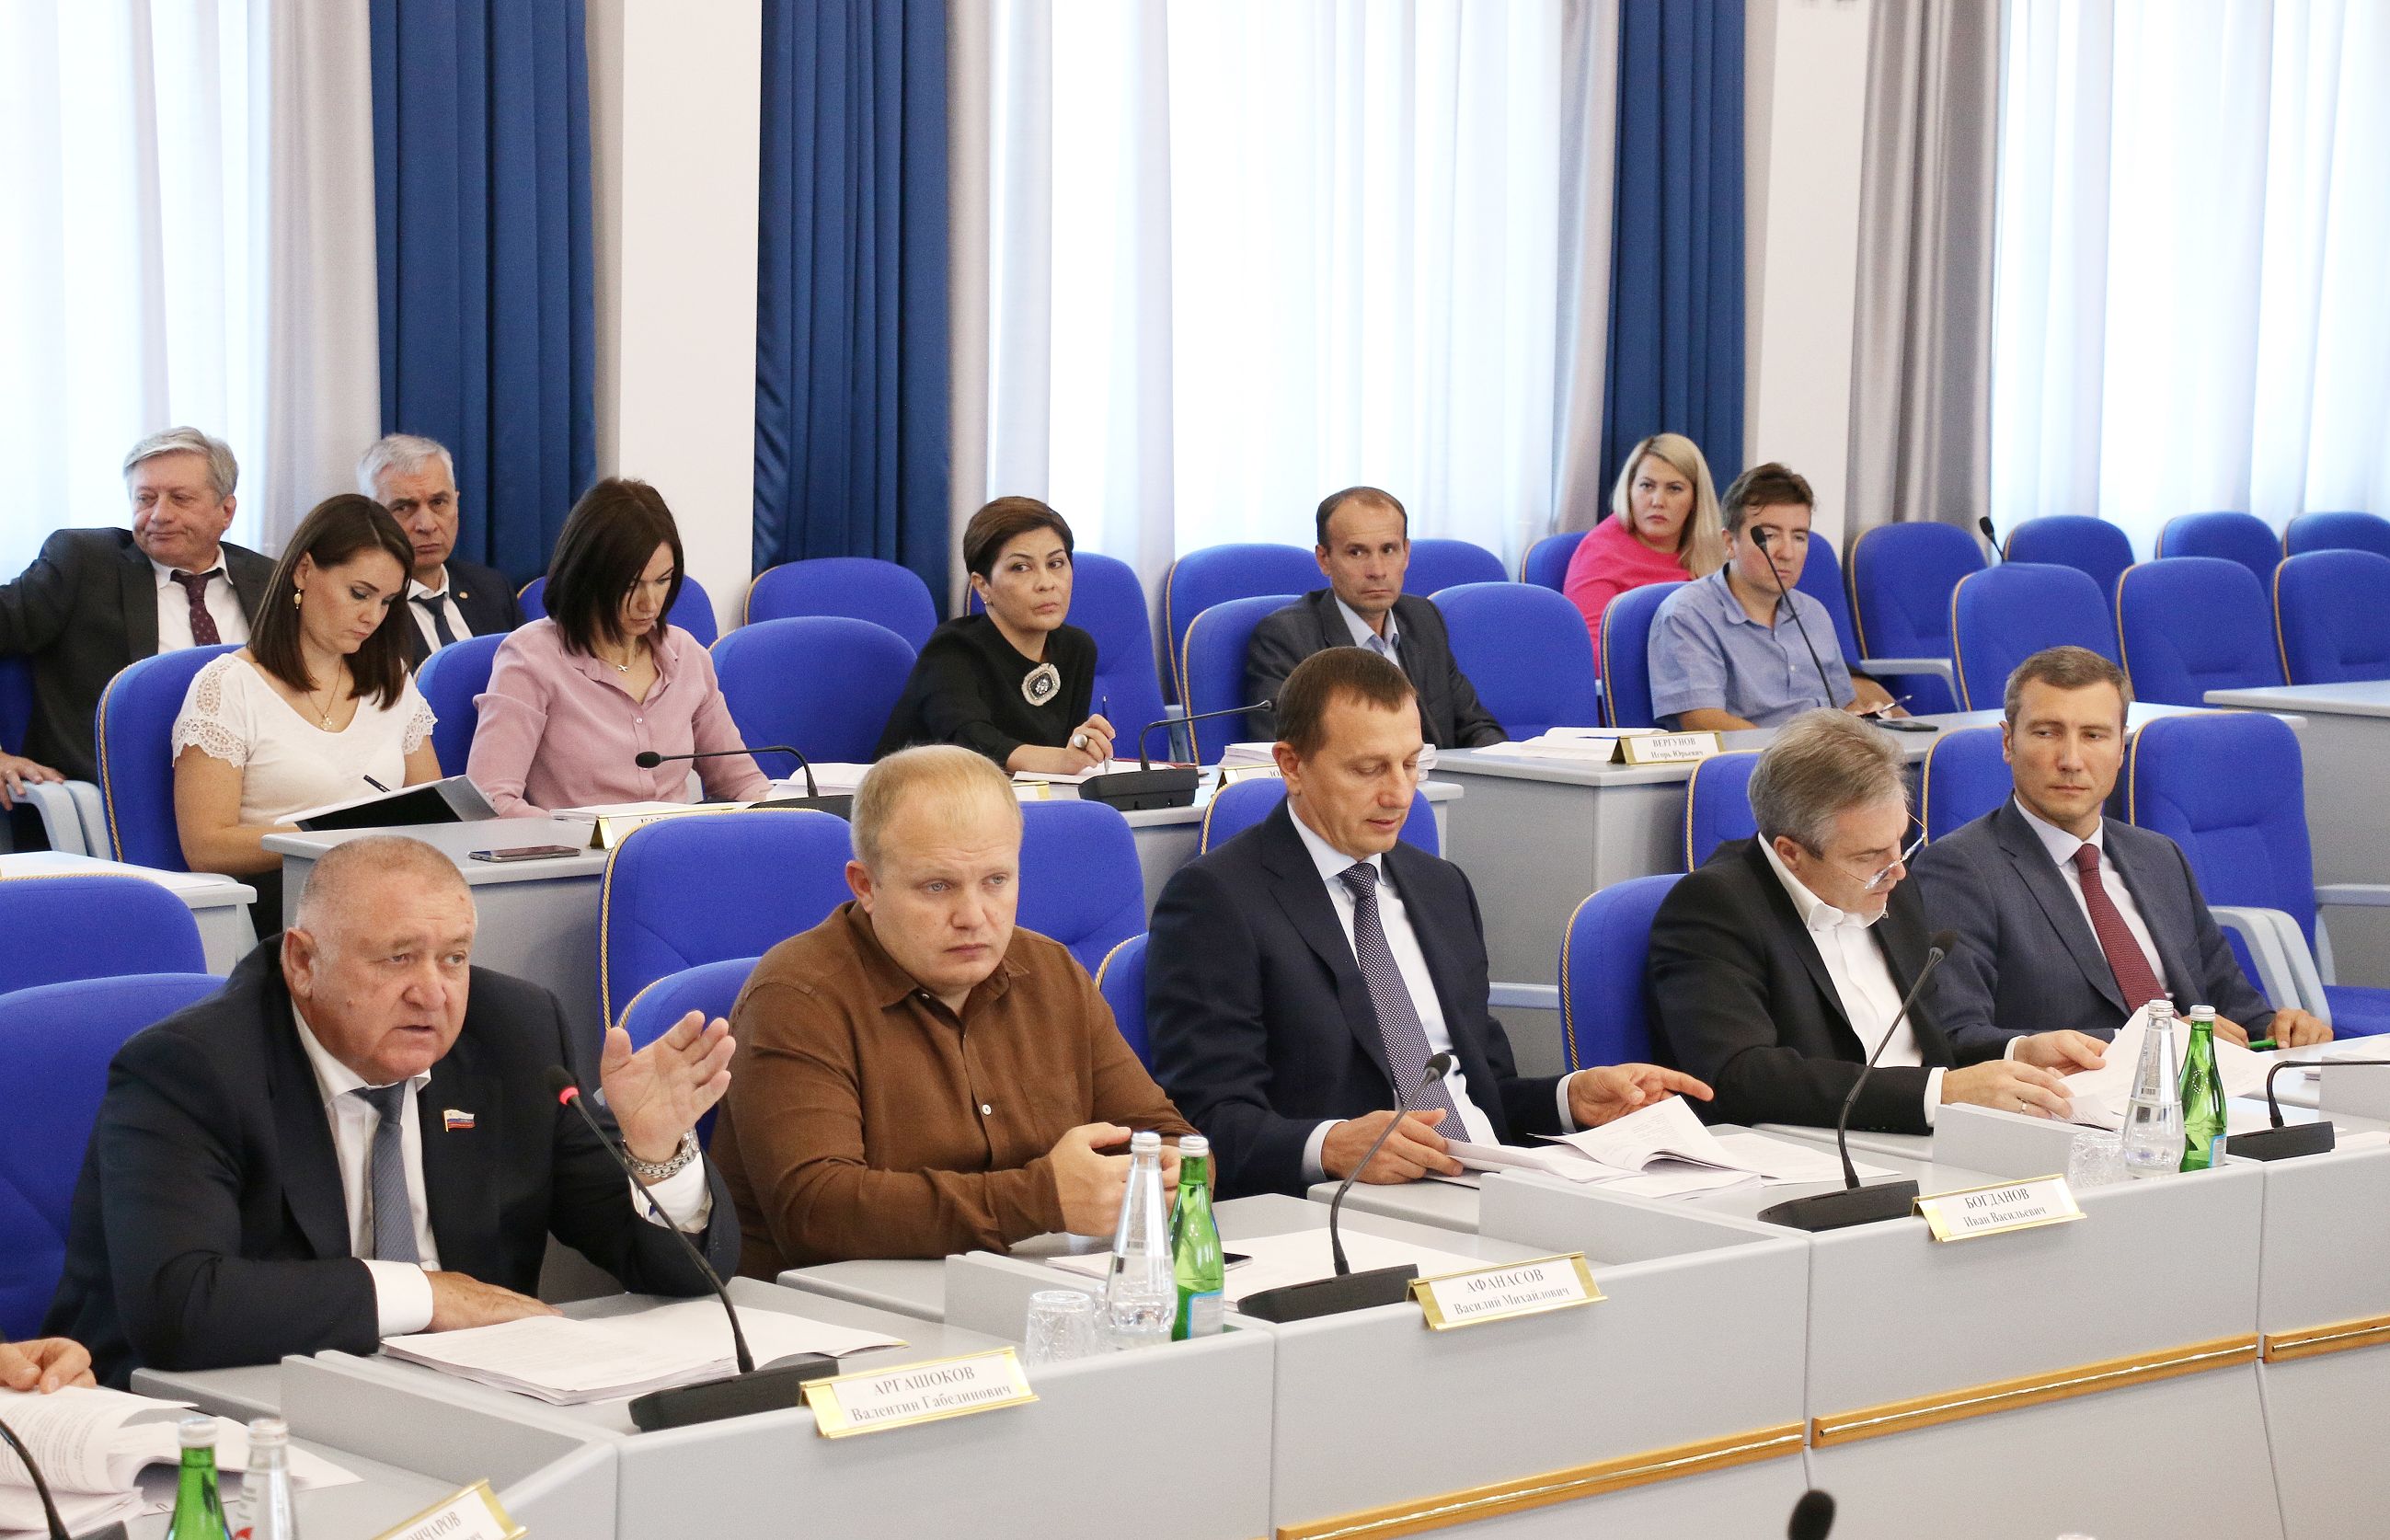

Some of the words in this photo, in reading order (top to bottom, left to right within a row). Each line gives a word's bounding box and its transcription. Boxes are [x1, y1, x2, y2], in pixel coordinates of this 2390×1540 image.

[1652, 738, 1696, 748] ВЕРГУНОВ
[1964, 1188, 2029, 1209] БОГДАНОВ
[1963, 1215, 1991, 1227] Иван
[1990, 1206, 2047, 1223] Васильевич
[1465, 1269, 1544, 1293] АФАНАСОВ
[1454, 1297, 1501, 1315] Василий
[1502, 1287, 1570, 1305] Михайлович
[874, 1366, 975, 1396] АРГАШОКОВ
[851, 1401, 920, 1421] Валентин
